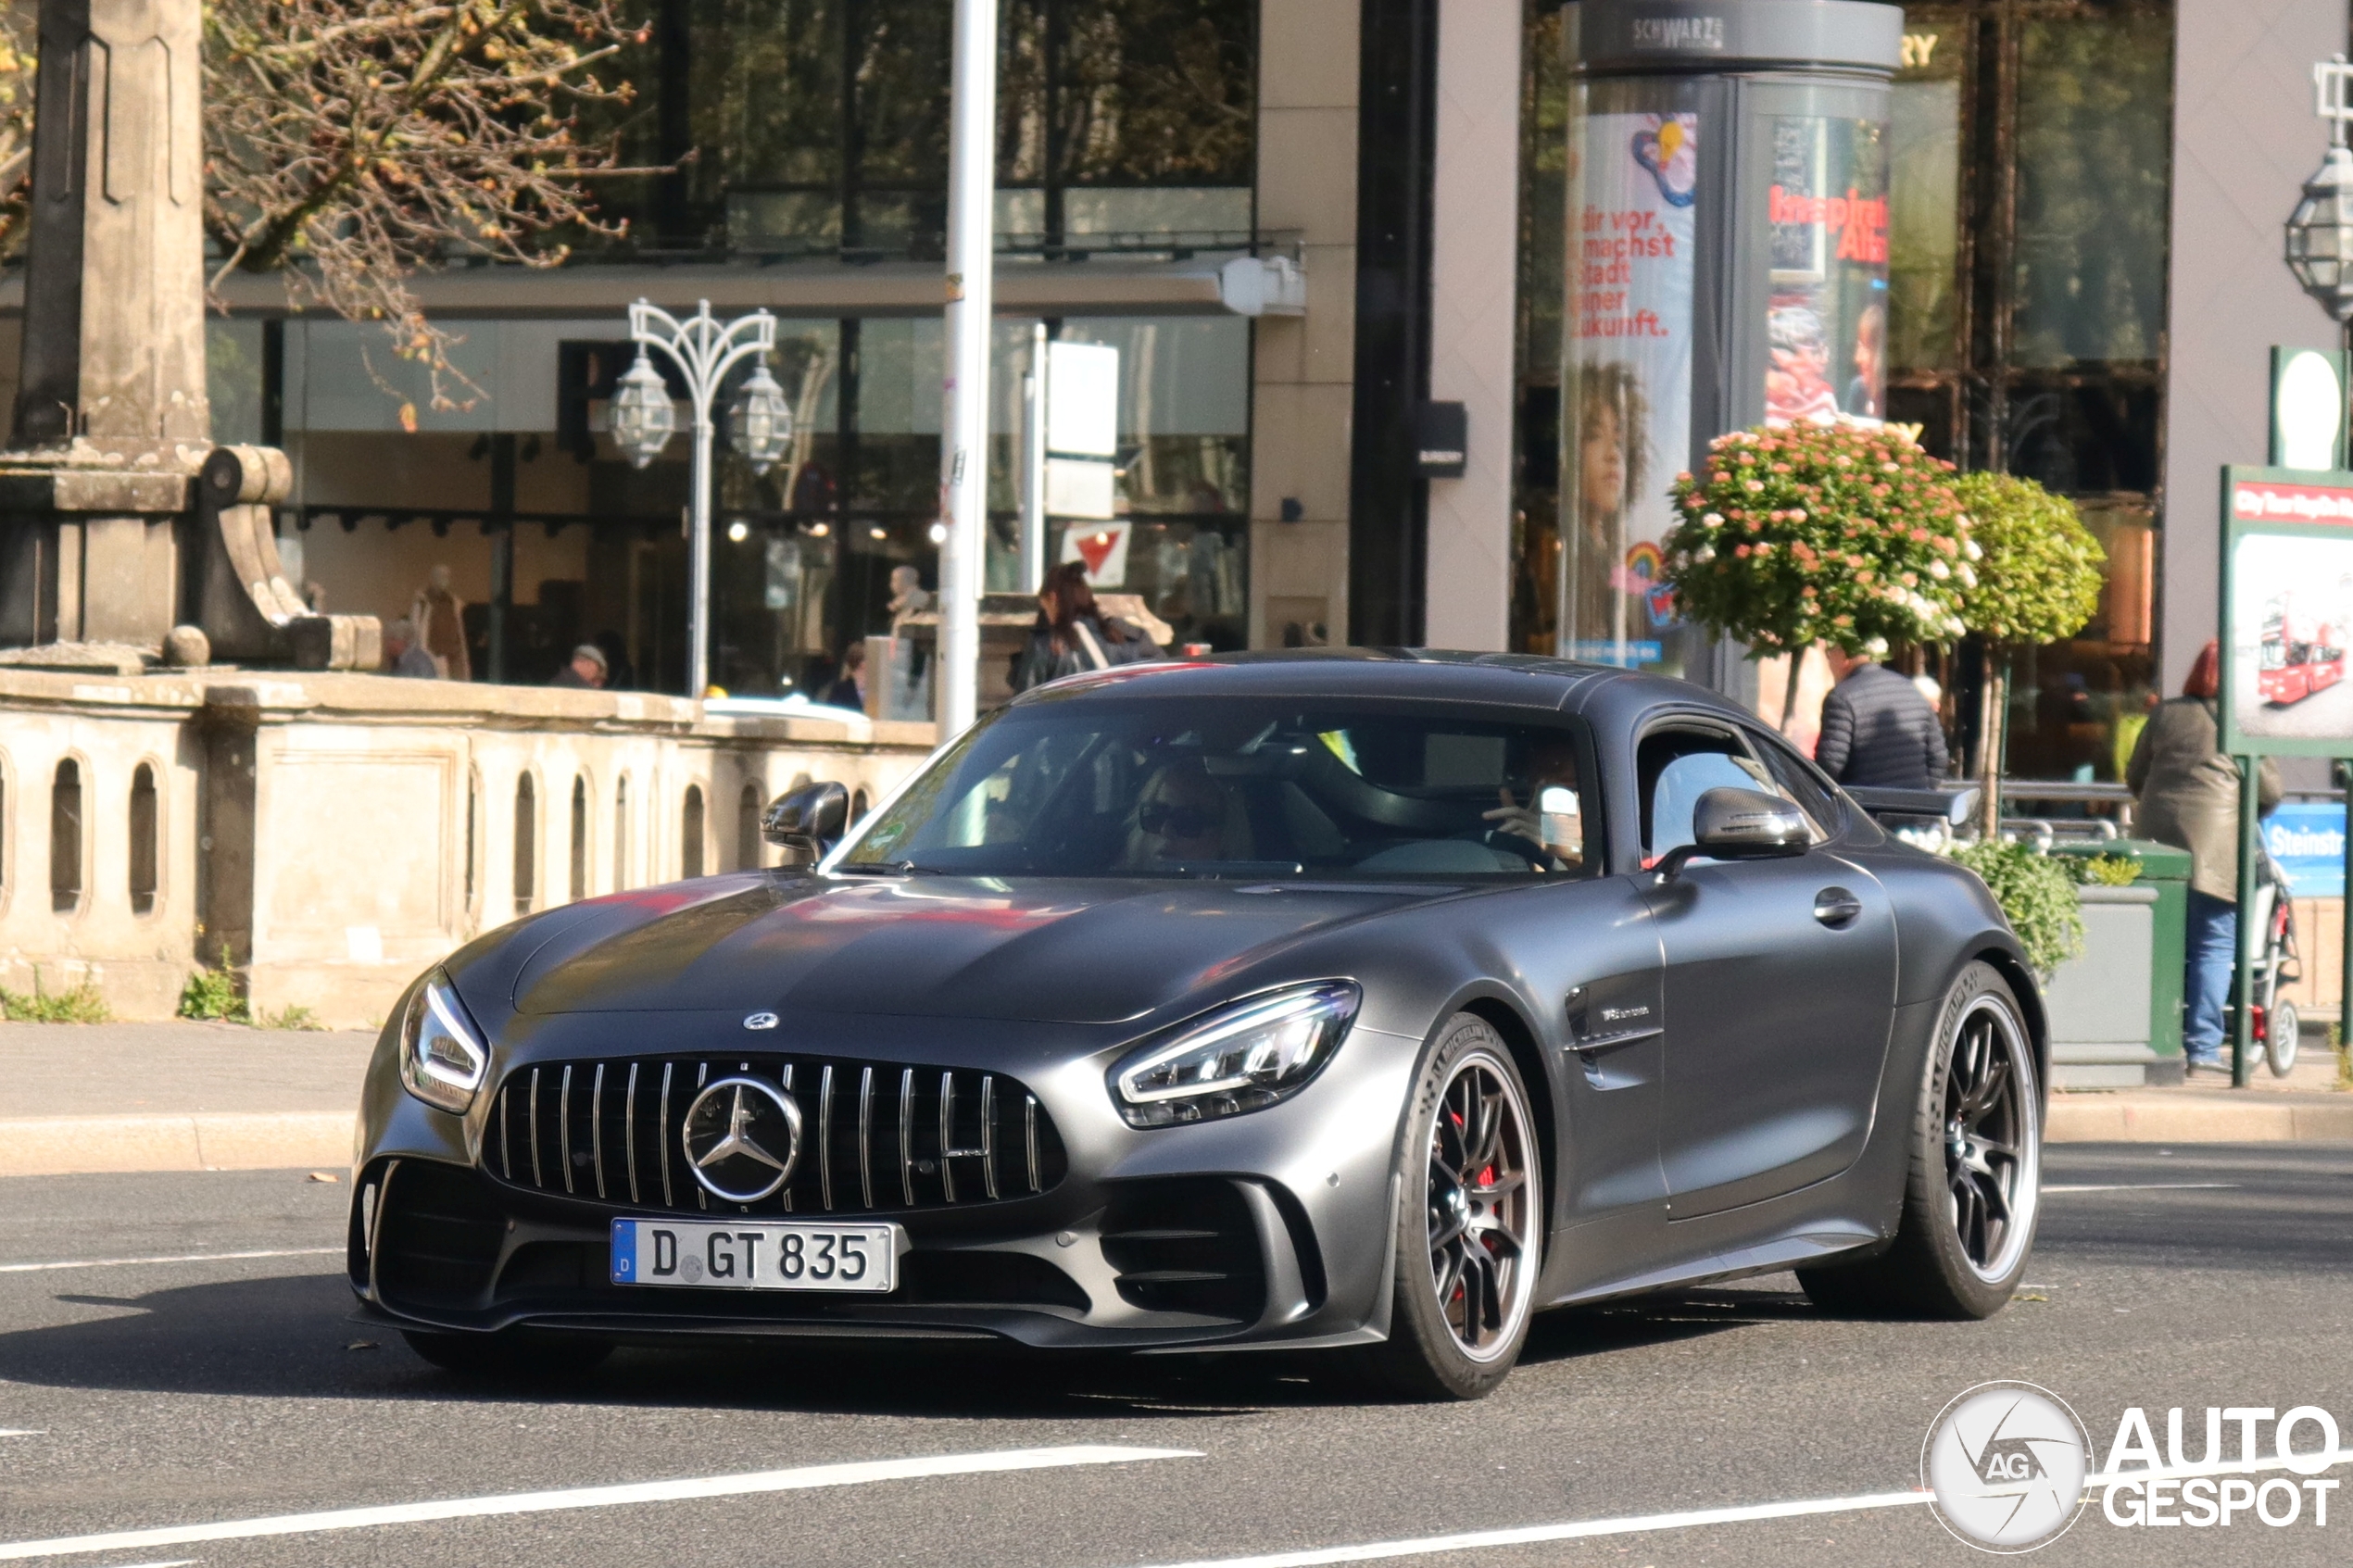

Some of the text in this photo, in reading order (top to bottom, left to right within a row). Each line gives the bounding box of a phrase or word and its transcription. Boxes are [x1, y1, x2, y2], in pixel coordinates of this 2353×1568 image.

[621, 1259, 629, 1272] D
[652, 1230, 866, 1280] D GT 835
